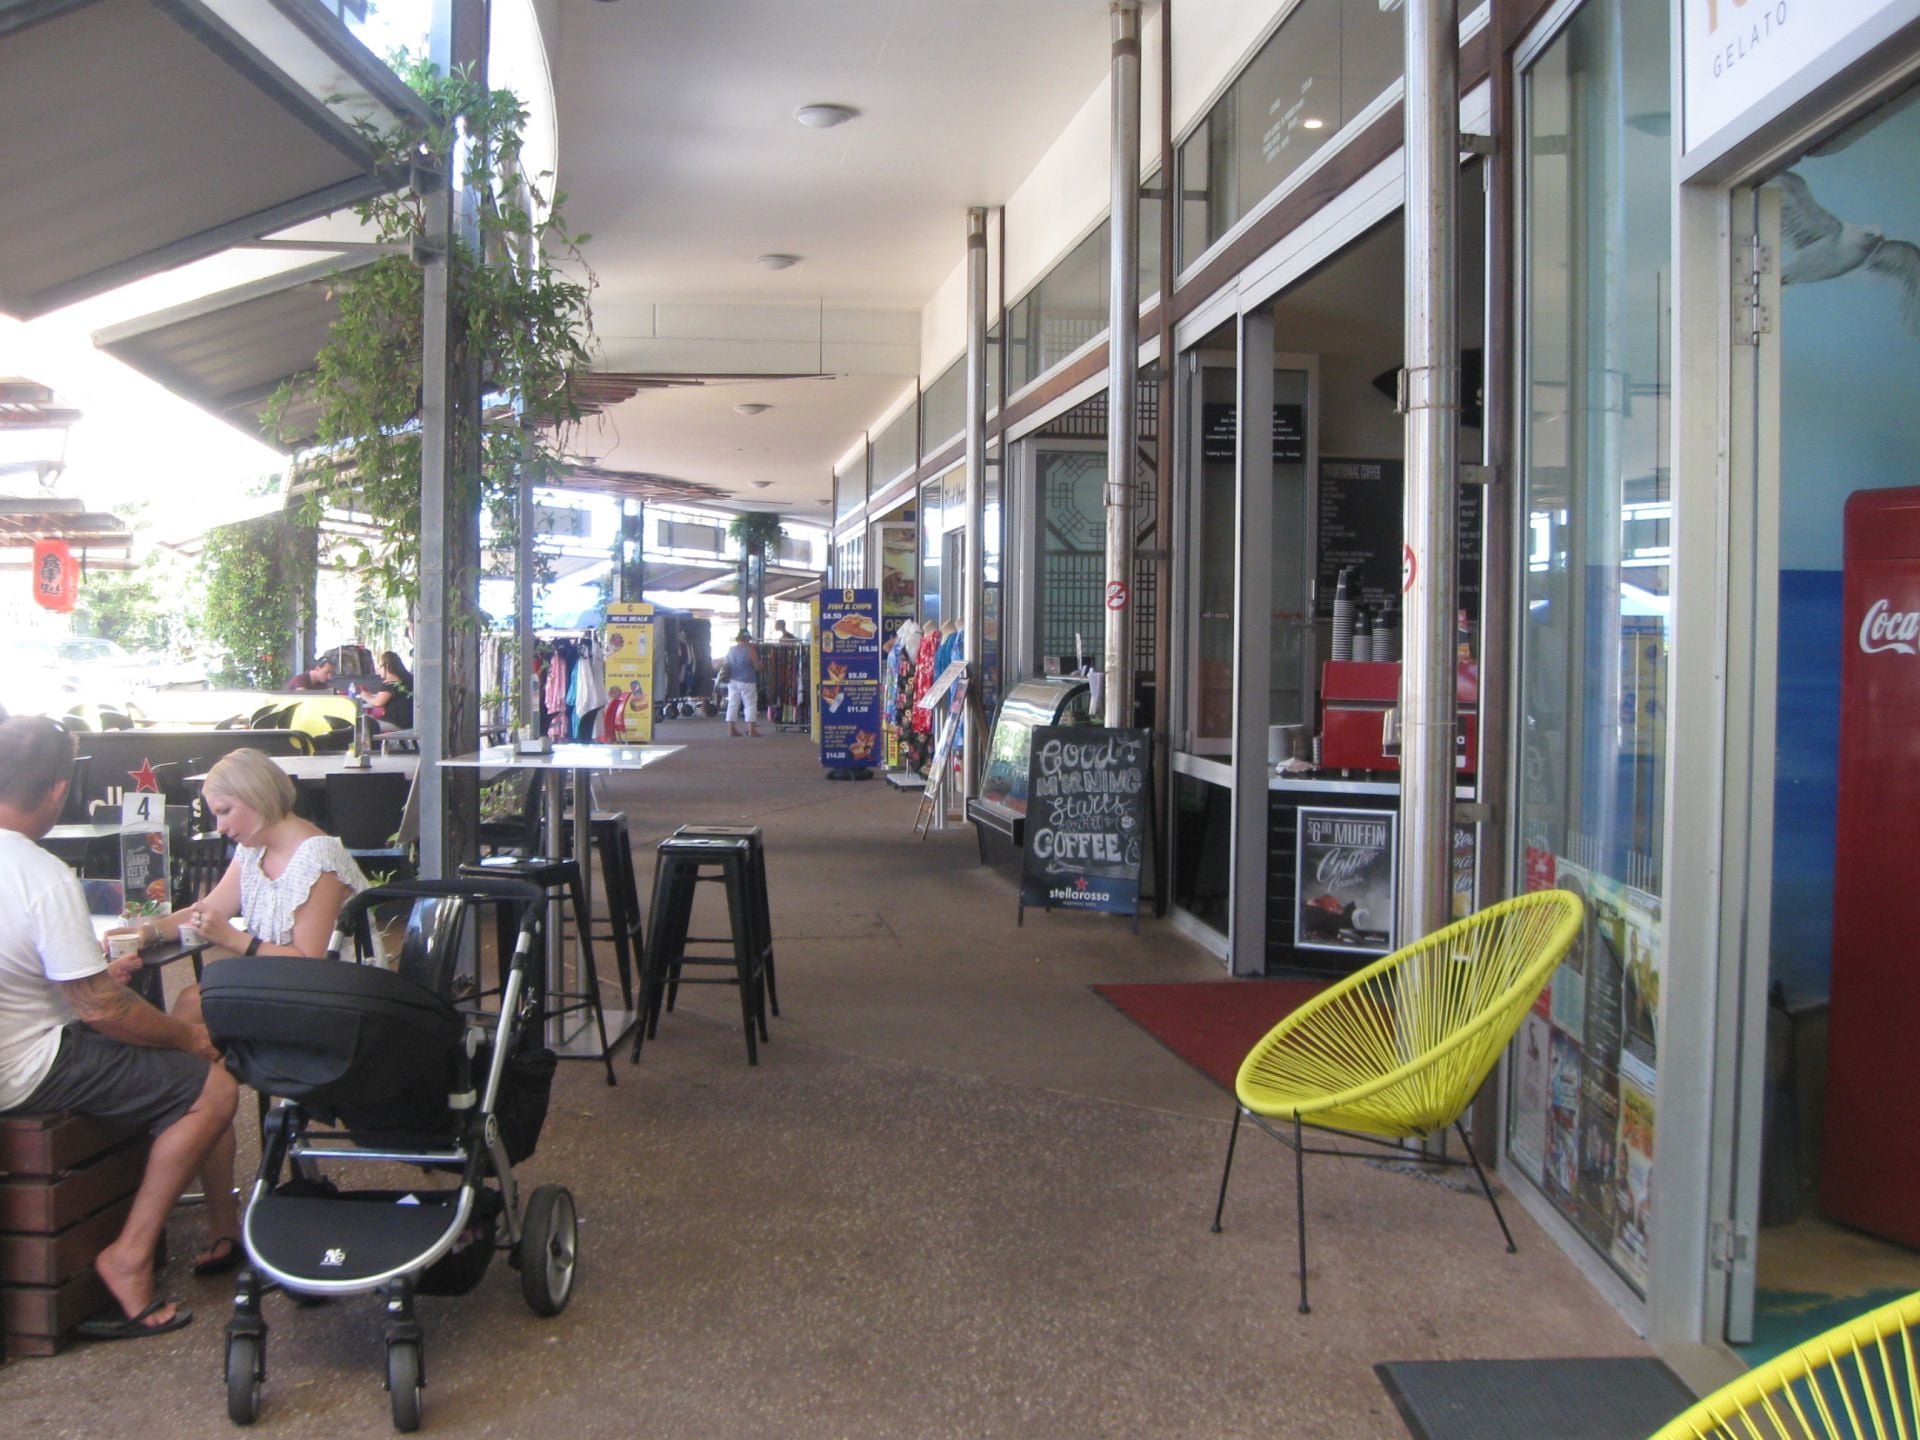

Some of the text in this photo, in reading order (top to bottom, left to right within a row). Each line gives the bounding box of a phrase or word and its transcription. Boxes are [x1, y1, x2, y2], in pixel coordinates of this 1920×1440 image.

[1713, 0, 1787, 78] GELATO
[827, 603, 844, 611] FISH
[852, 603, 873, 611] CHIPS
[1036, 736, 1119, 779] Good
[137, 796, 150, 821] 4
[1033, 828, 1122, 862] COFFEE
[1333, 822, 1386, 846] MUFFIN
[1049, 887, 1110, 902] stellarossa
